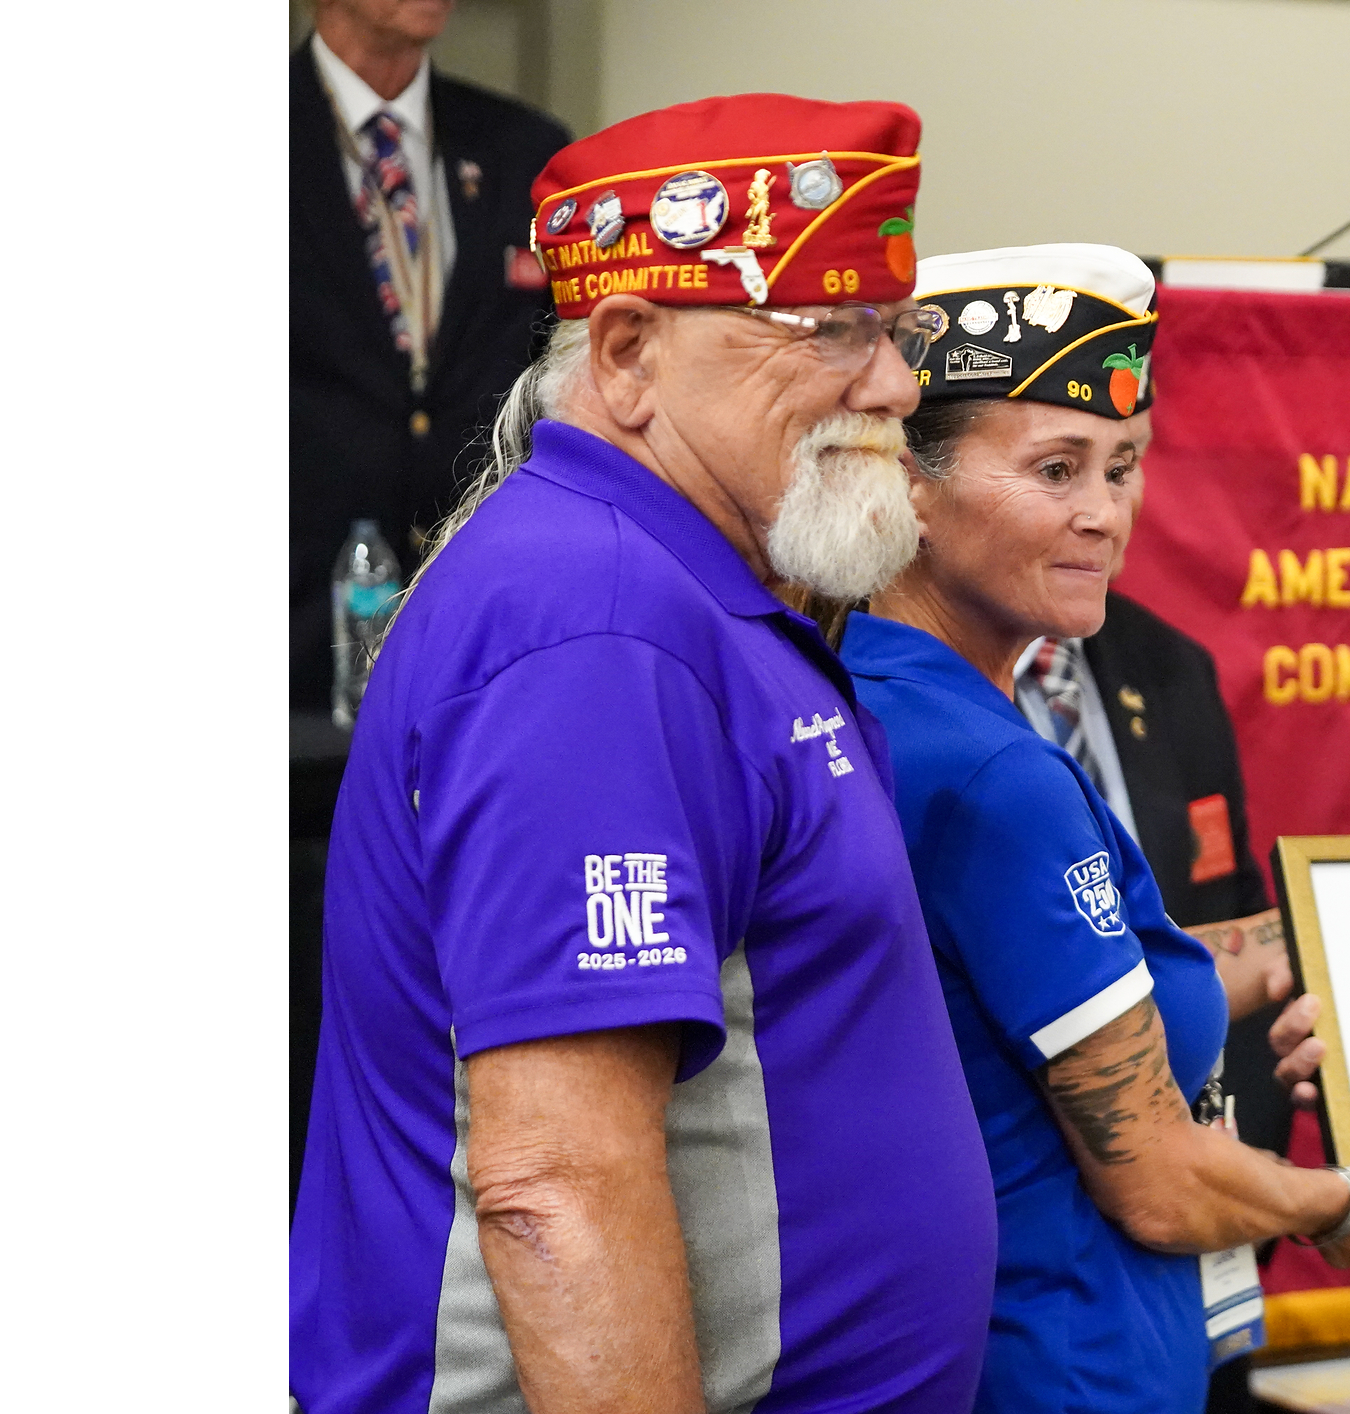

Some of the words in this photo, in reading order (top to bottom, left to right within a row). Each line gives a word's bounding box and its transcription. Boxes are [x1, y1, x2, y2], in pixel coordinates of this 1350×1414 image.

[558, 232, 654, 269] NATIONAL
[585, 264, 708, 299] COMMITTEE
[822, 268, 860, 295] 69
[1067, 380, 1093, 402] 90
[584, 854, 624, 895] BE
[623, 860, 668, 884] THE
[1073, 857, 1108, 885] USA
[1082, 878, 1116, 917] 250
[586, 890, 670, 949] ONE
[577, 946, 688, 970] 2025-2026
